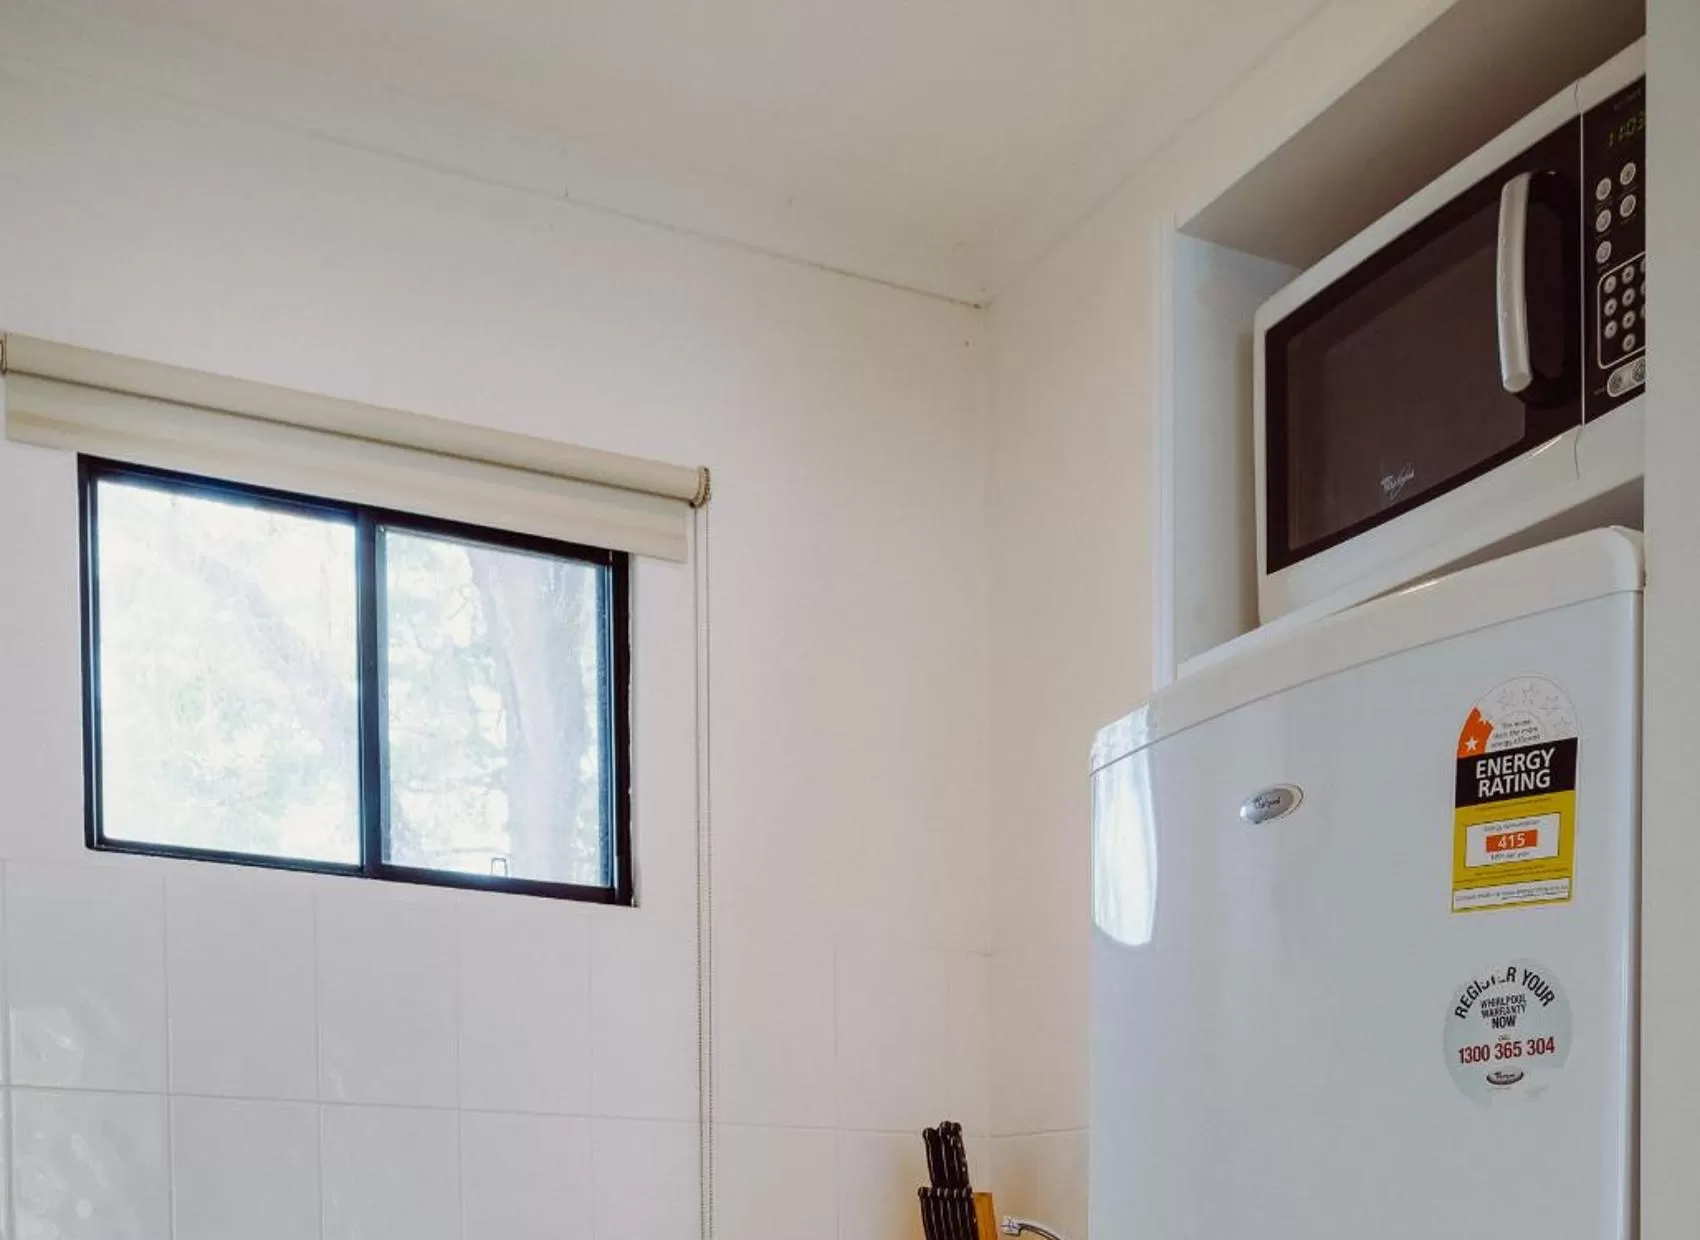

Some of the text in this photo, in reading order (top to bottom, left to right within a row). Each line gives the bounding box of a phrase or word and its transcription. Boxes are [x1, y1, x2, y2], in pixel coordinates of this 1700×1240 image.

[1476, 747, 1555, 779] ENERGY
[1478, 769, 1550, 798] RATING
[1498, 833, 1525, 850] 415
[1455, 966, 1555, 1019] REGIR YOUR
[1491, 1015, 1517, 1029] NOW
[1458, 1036, 1555, 1064] 1300 365 304
